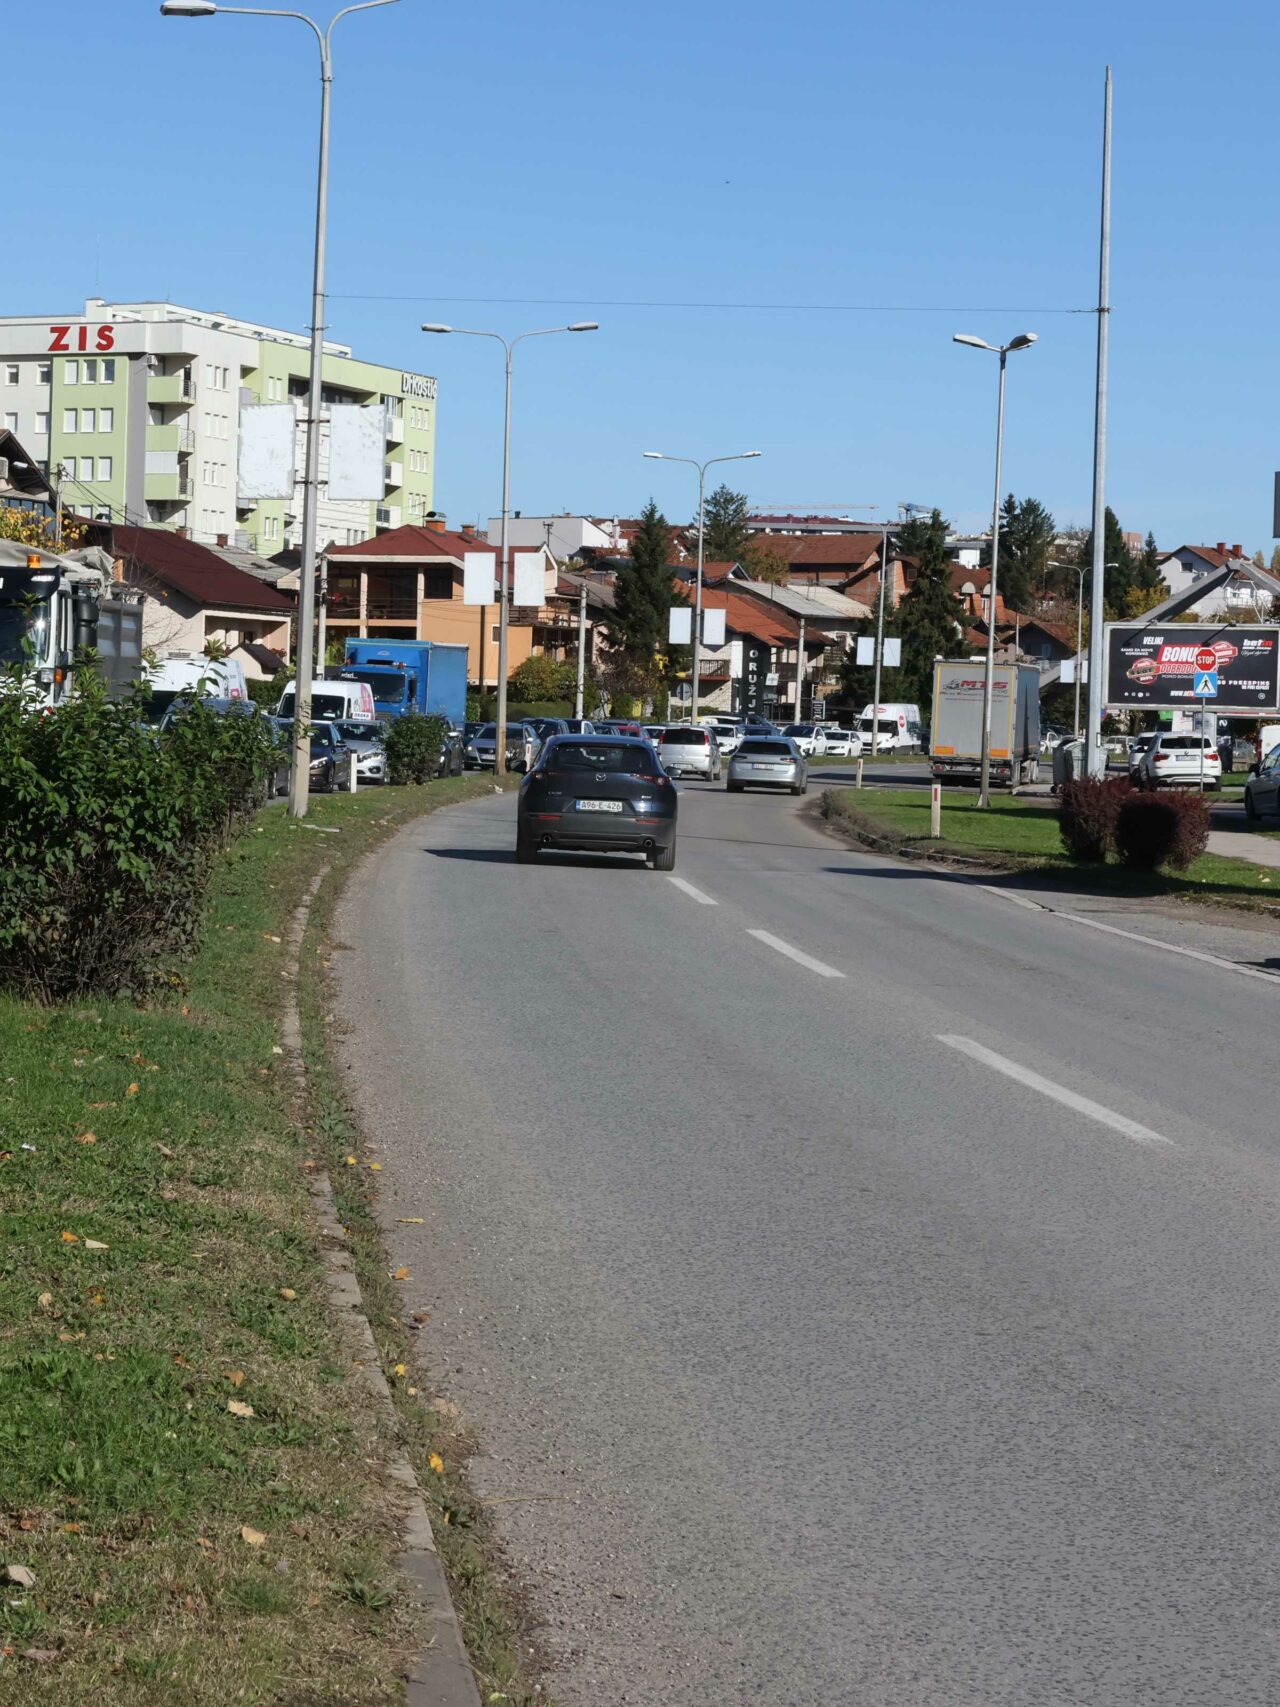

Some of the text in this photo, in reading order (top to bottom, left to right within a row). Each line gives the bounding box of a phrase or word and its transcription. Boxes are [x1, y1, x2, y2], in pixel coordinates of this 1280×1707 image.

[48, 325, 115, 351] ZIS
[1197, 656, 1215, 664] STOP
[748, 649, 759, 714] ORUŽJ
